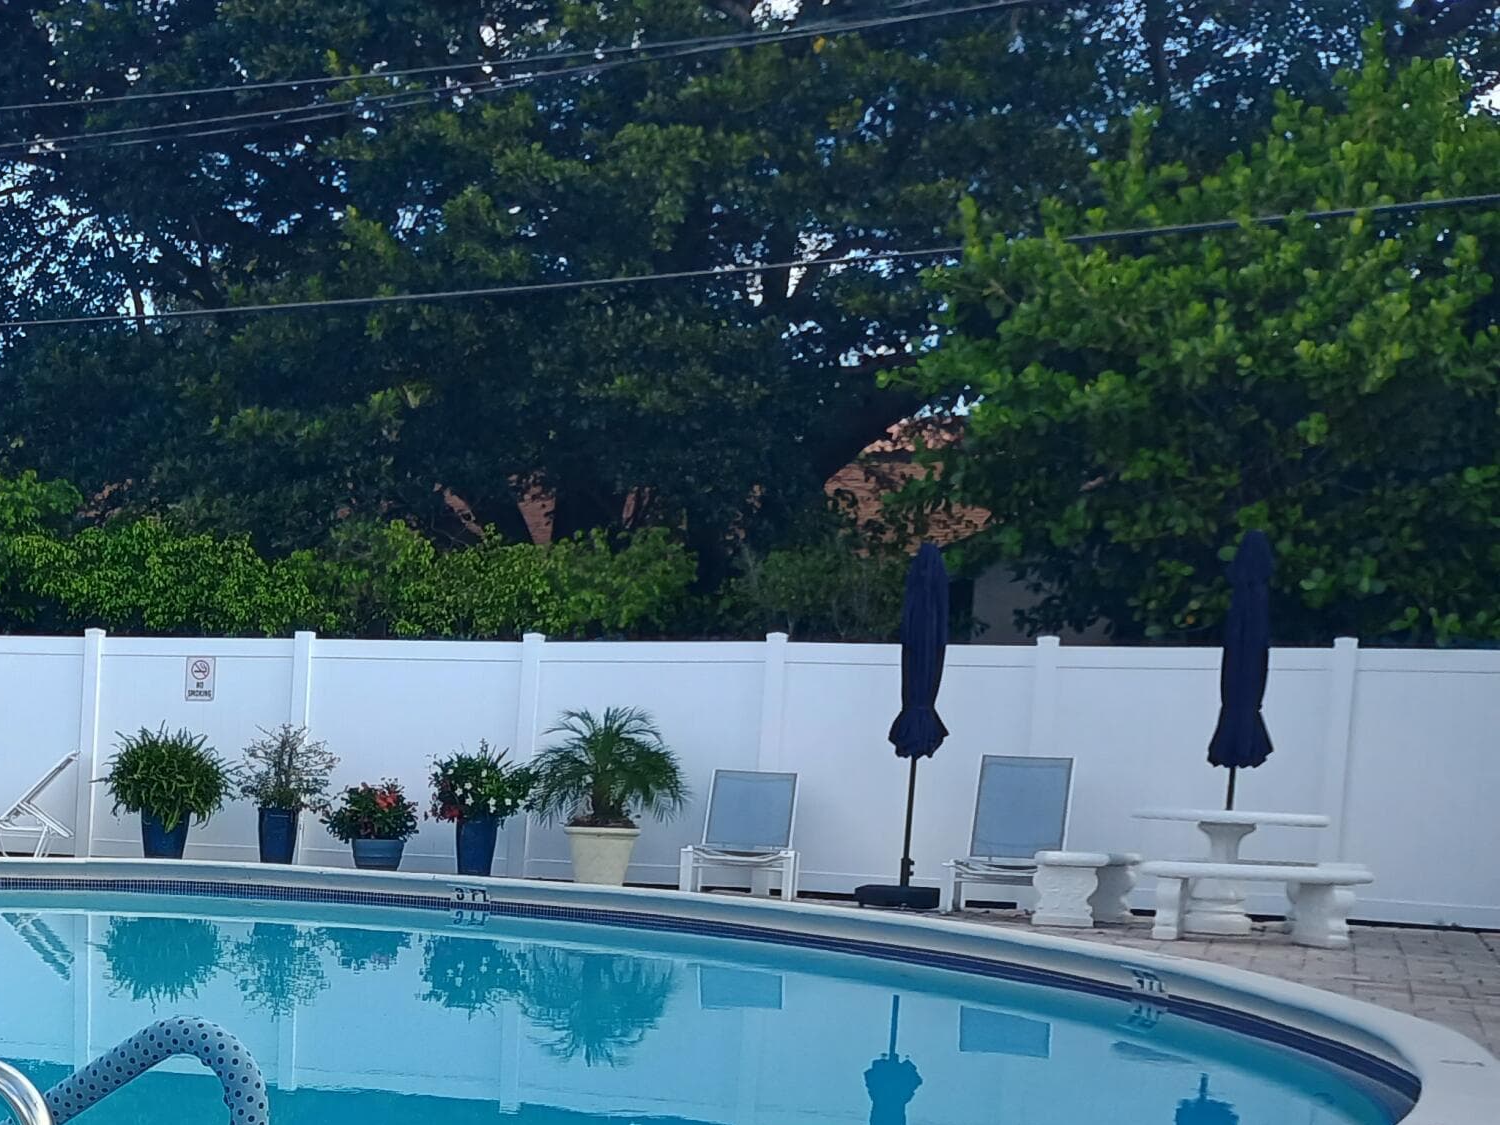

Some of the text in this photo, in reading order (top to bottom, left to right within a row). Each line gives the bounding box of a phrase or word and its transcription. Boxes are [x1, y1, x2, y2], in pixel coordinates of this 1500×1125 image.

[196, 681, 204, 689] NO
[187, 689, 212, 697] SMOKING
[455, 887, 465, 900] 3
